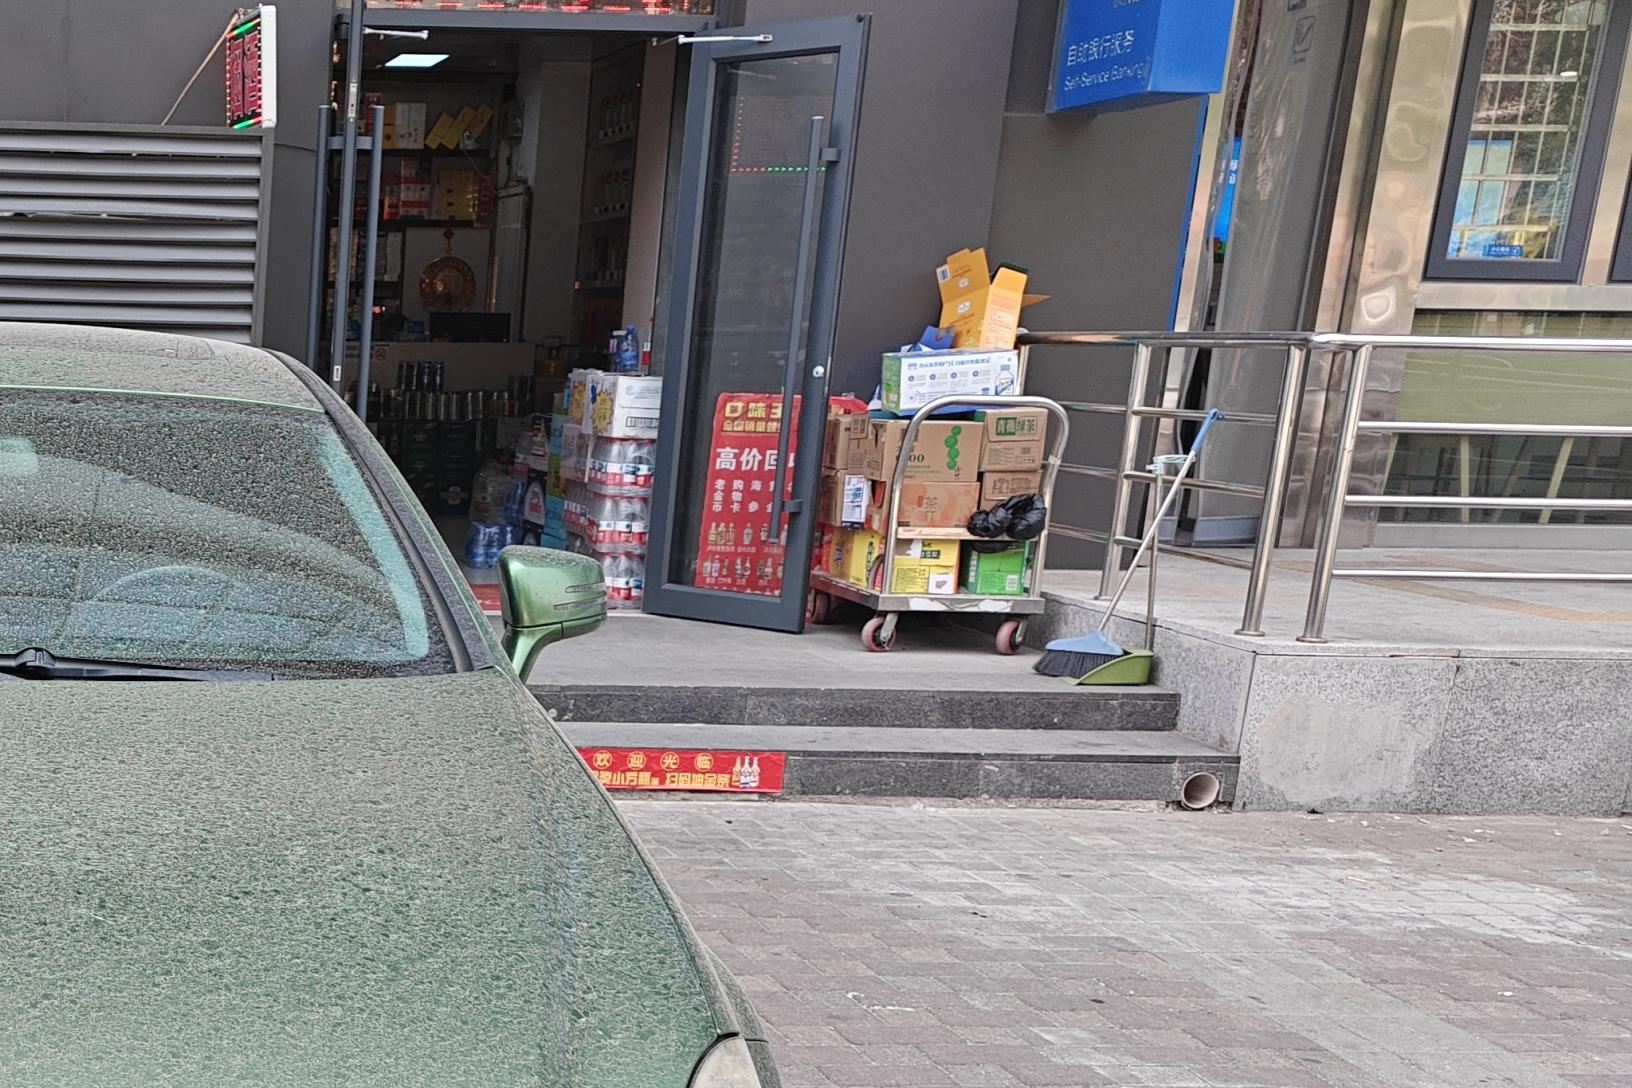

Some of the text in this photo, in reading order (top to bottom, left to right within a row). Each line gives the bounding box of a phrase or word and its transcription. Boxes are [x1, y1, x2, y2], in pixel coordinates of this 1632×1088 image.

[1067, 30, 1135, 66] 自助银行服务
[594, 751, 712, 772] 欢迎光临
